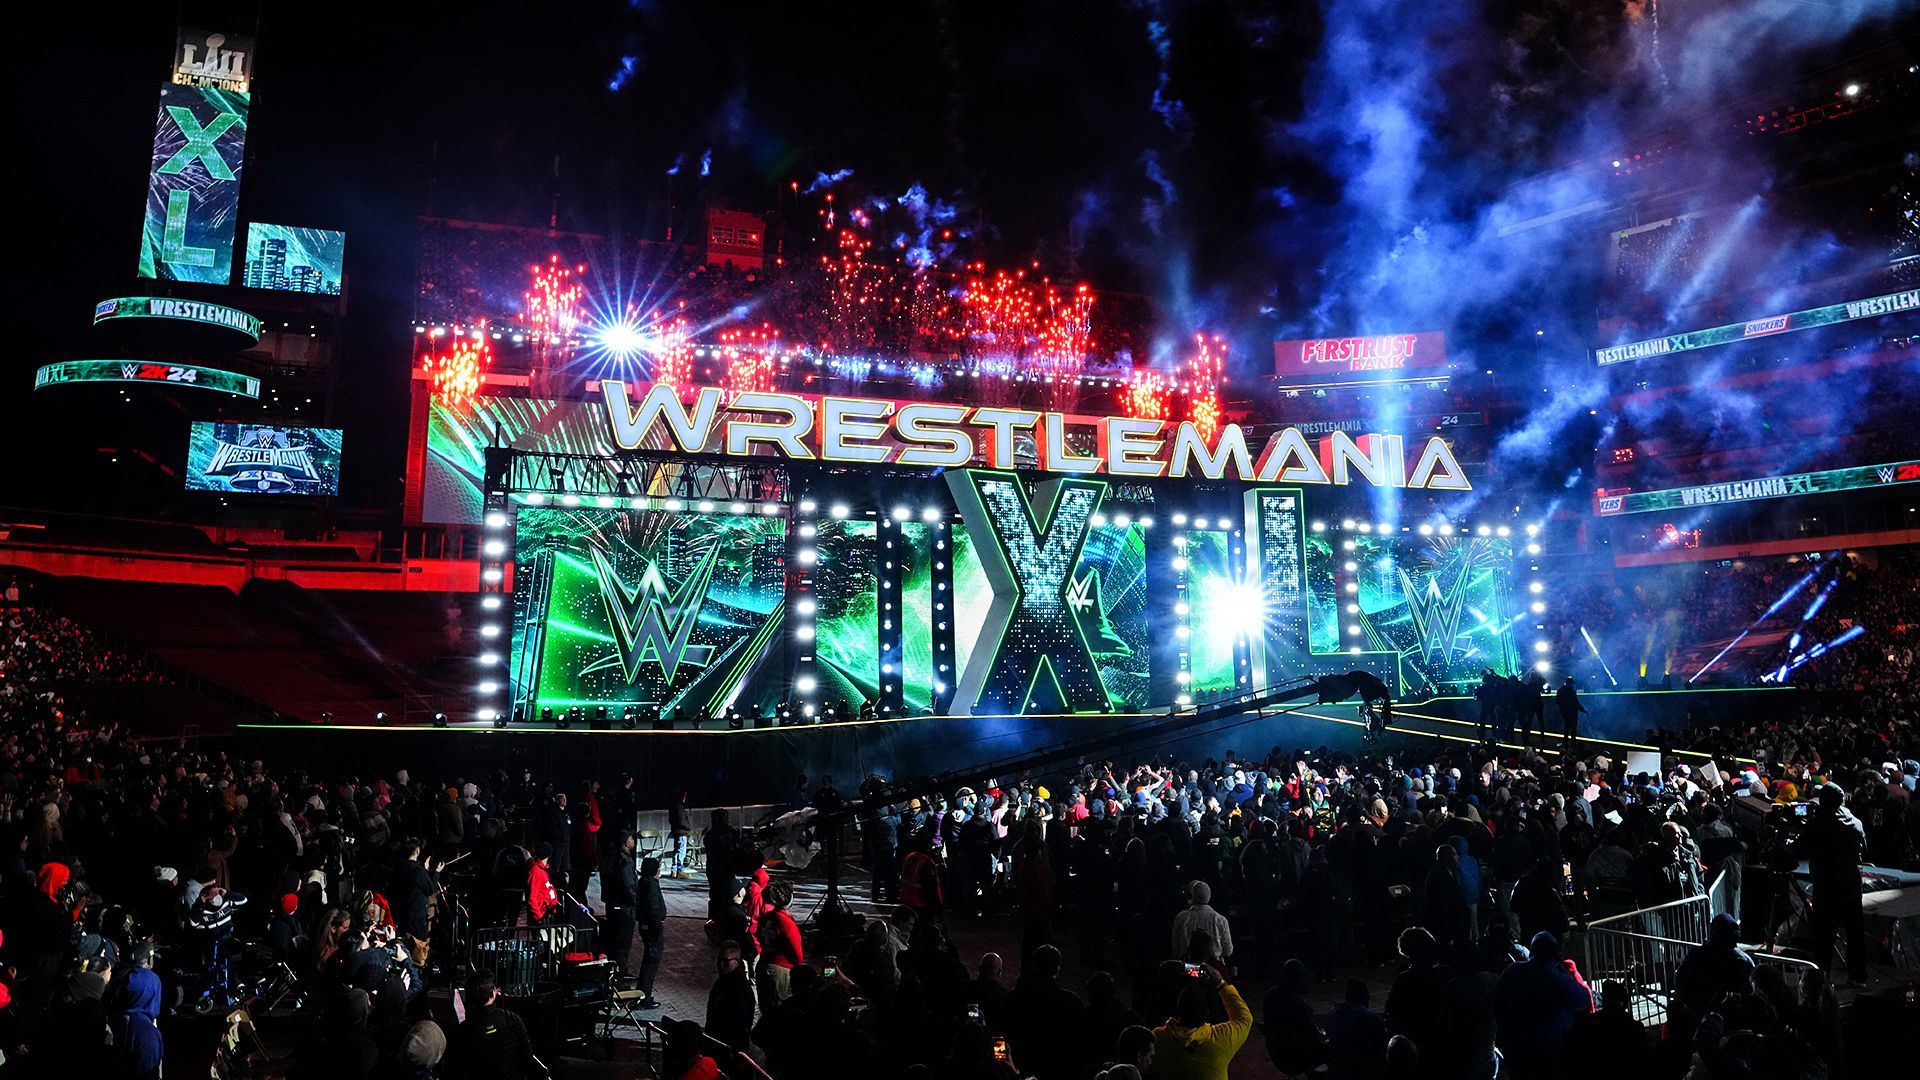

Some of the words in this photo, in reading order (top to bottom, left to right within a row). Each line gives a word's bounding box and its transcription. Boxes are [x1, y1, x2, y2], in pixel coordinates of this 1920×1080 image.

[150, 299, 248, 331] WRESTLEMANIA
[1746, 318, 1785, 334] SNICKERS
[1350, 357, 1404, 371] BANK
[1597, 338, 1671, 364] RESTLEMANIA
[1670, 335, 1695, 350] XL
[49, 364, 69, 382] XL
[601, 379, 1471, 491] WRESTLEMANIA
[1681, 478, 1787, 505] WRESTLEMANIA
[1787, 474, 1819, 494] XL
